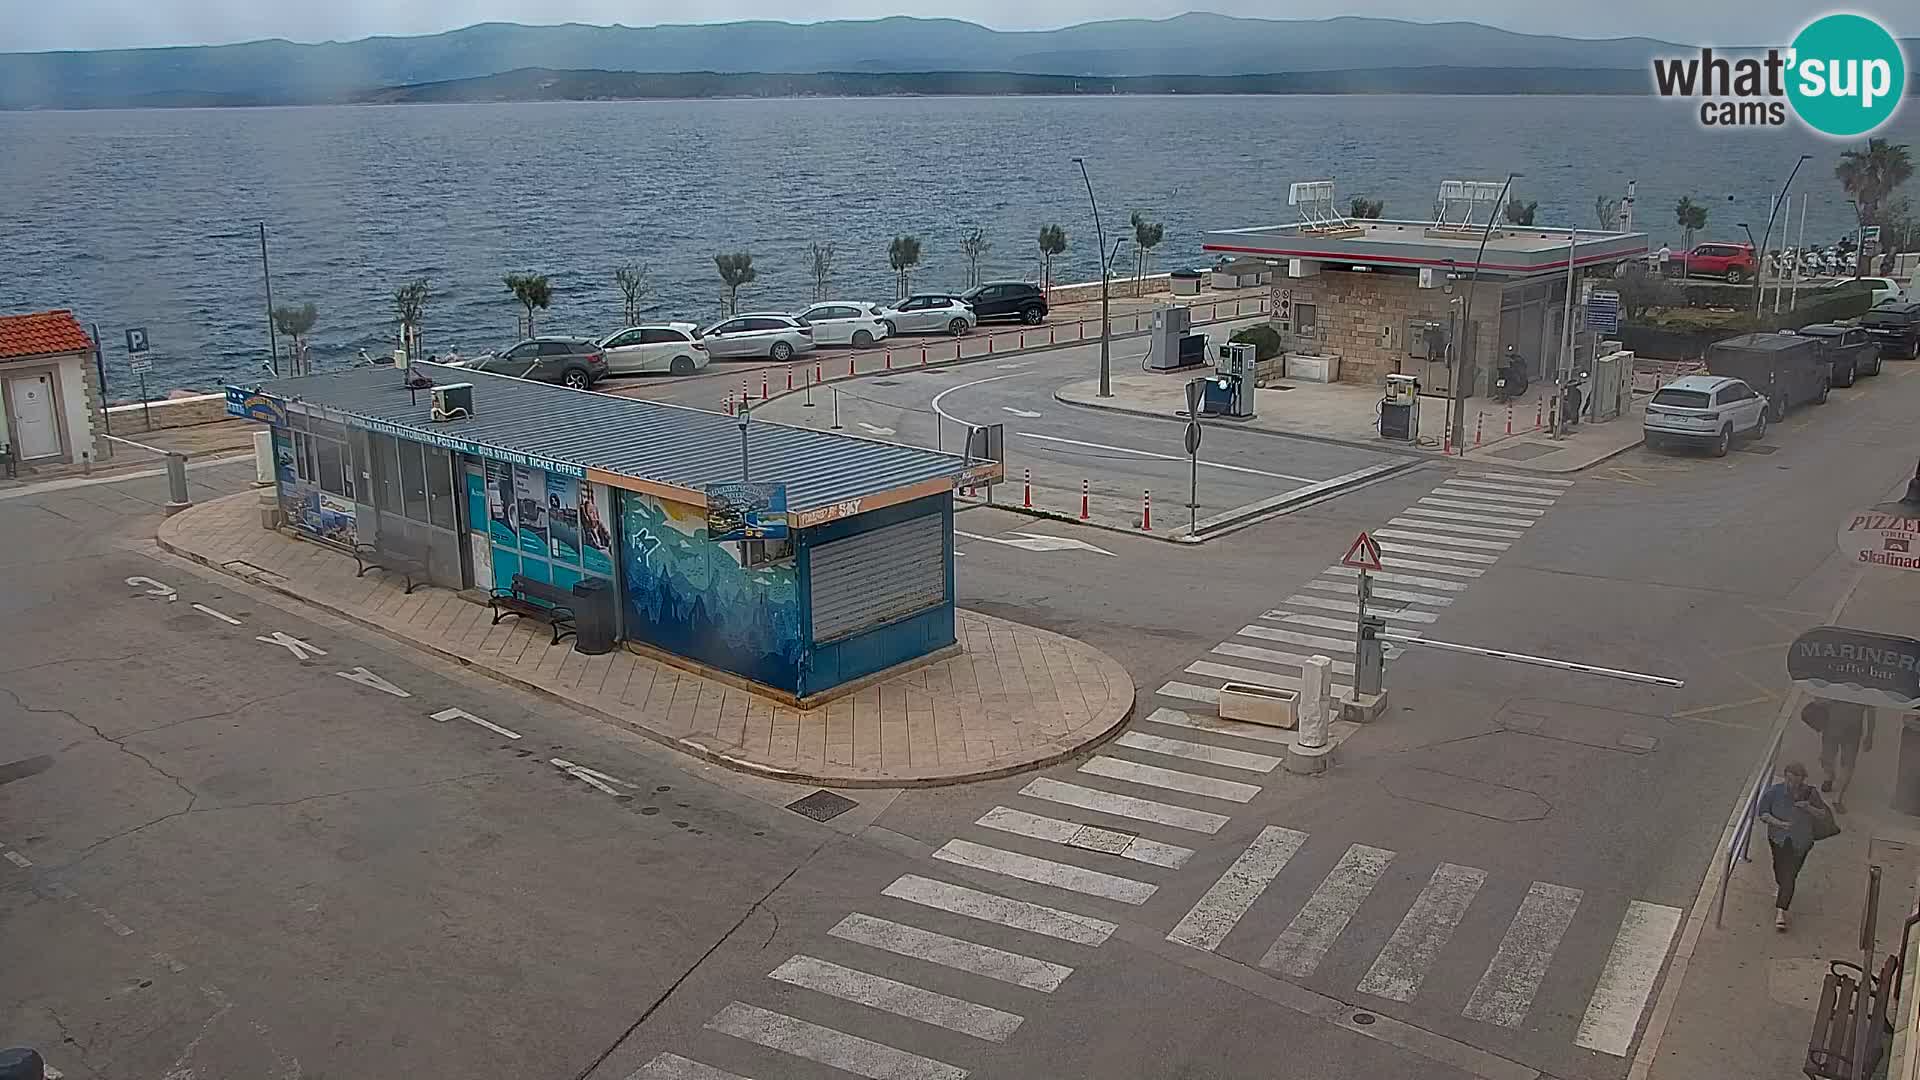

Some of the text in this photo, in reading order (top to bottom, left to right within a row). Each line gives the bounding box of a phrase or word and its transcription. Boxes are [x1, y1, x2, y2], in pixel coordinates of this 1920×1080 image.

[131, 331, 143, 349] P
[437, 436, 469, 452] POSTAJA
[479, 445, 493, 458] BUS
[495, 449, 527, 465] STATION
[529, 456, 555, 471] TICKET
[556, 463, 583, 477] OFFICE
[1848, 516, 1920, 534] PIZZE
[1870, 666, 1897, 680] bar
